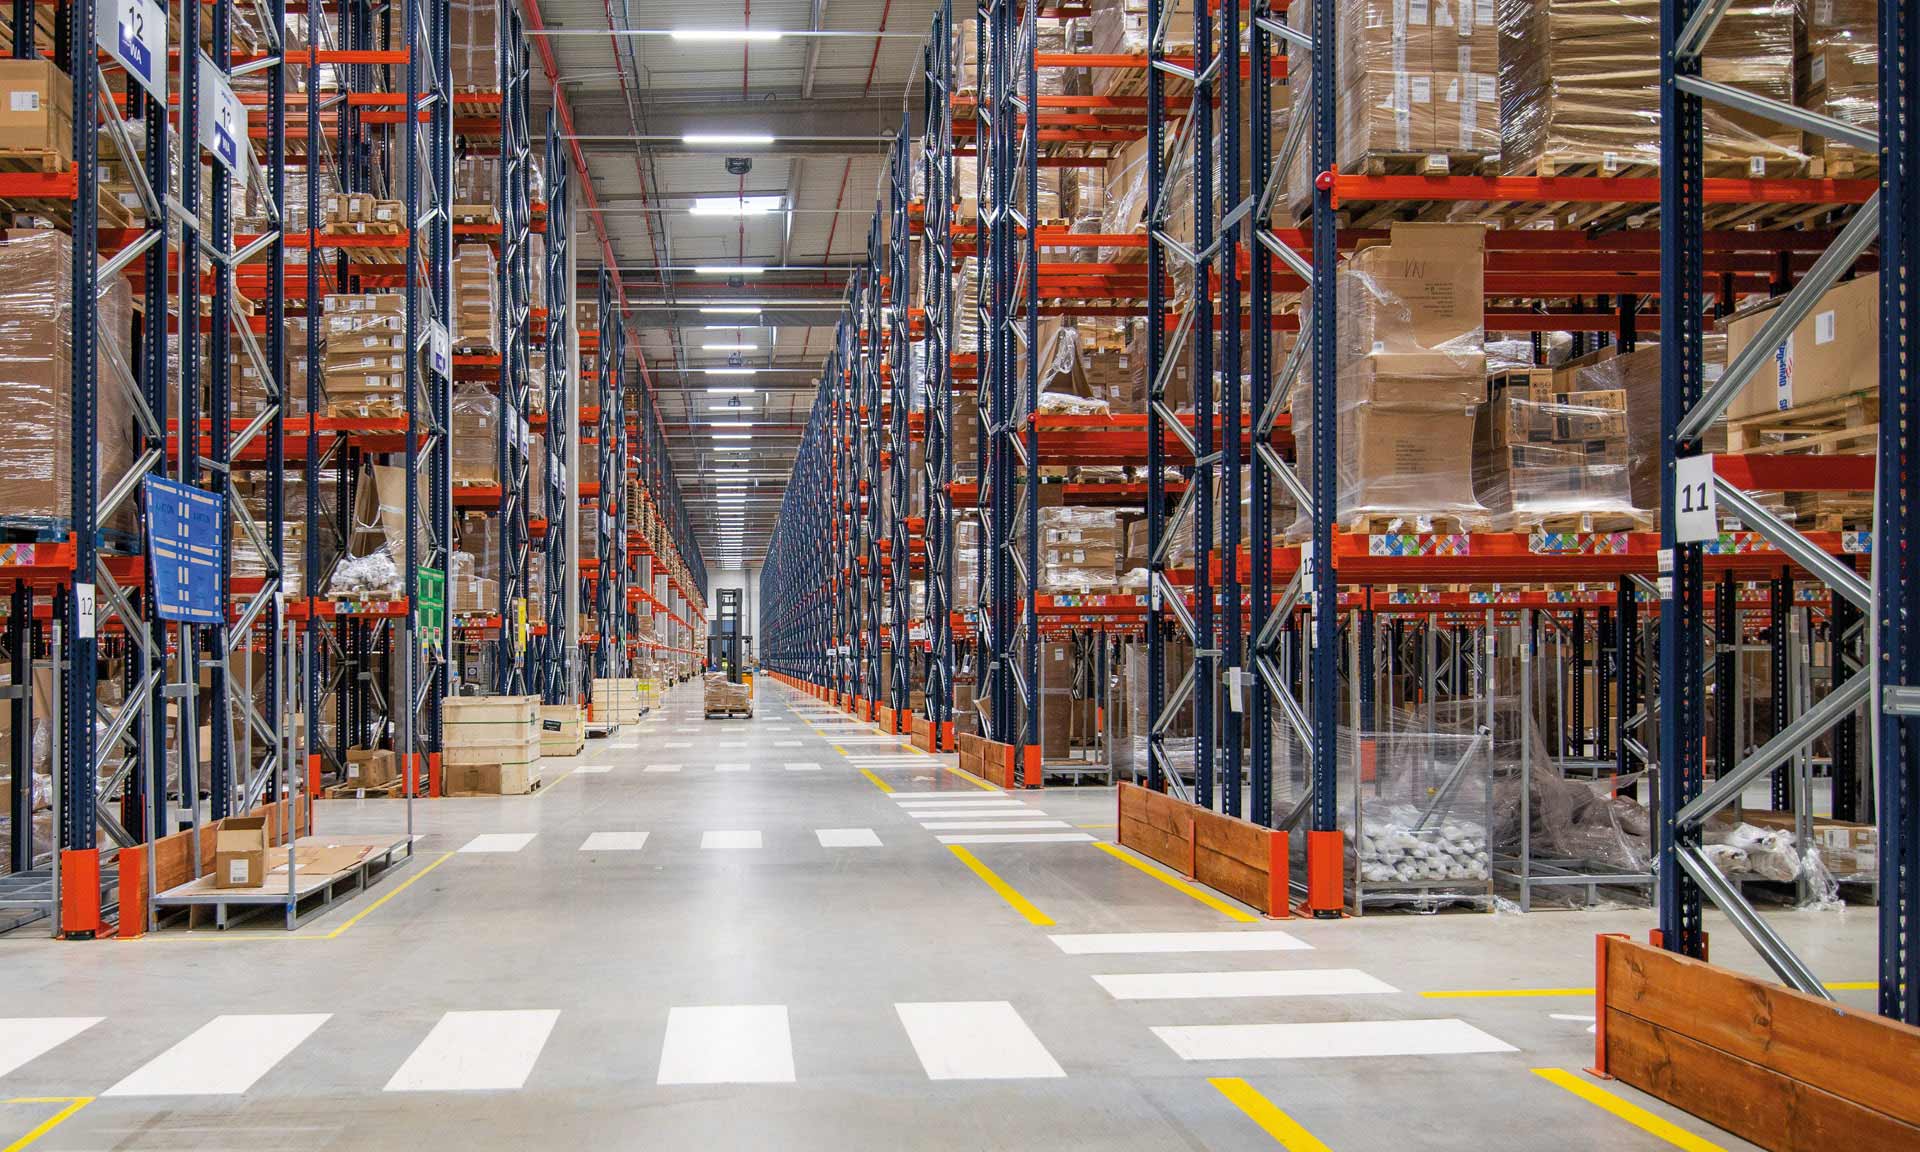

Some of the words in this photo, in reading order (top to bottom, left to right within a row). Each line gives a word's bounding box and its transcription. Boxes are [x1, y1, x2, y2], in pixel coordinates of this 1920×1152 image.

[128, 6, 144, 42] 12
[1681, 482, 1709, 513] 11
[1303, 557, 1315, 575] 12
[82, 597, 93, 615] 12
